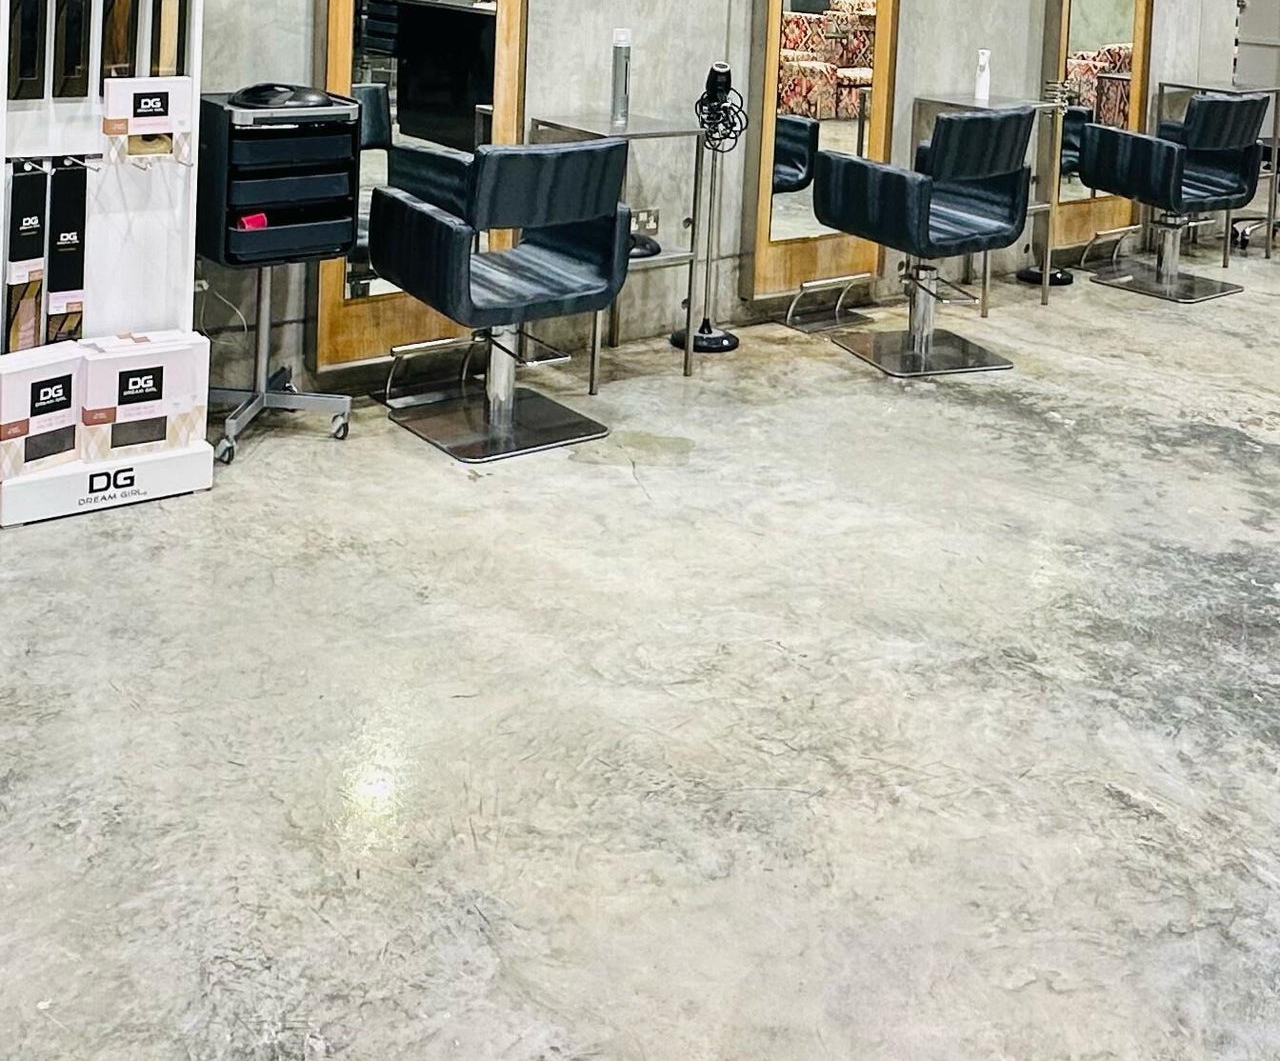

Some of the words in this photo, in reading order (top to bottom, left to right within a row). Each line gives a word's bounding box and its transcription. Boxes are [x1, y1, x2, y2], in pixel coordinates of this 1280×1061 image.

[140, 98, 162, 109] DG
[22, 216, 39, 226] DG
[60, 231, 78, 242] DG
[128, 375, 154, 390] DG
[40, 384, 64, 401] DG
[88, 467, 135, 494] DG
[78, 493, 117, 506] DREAM
[120, 489, 144, 498] GIRL
